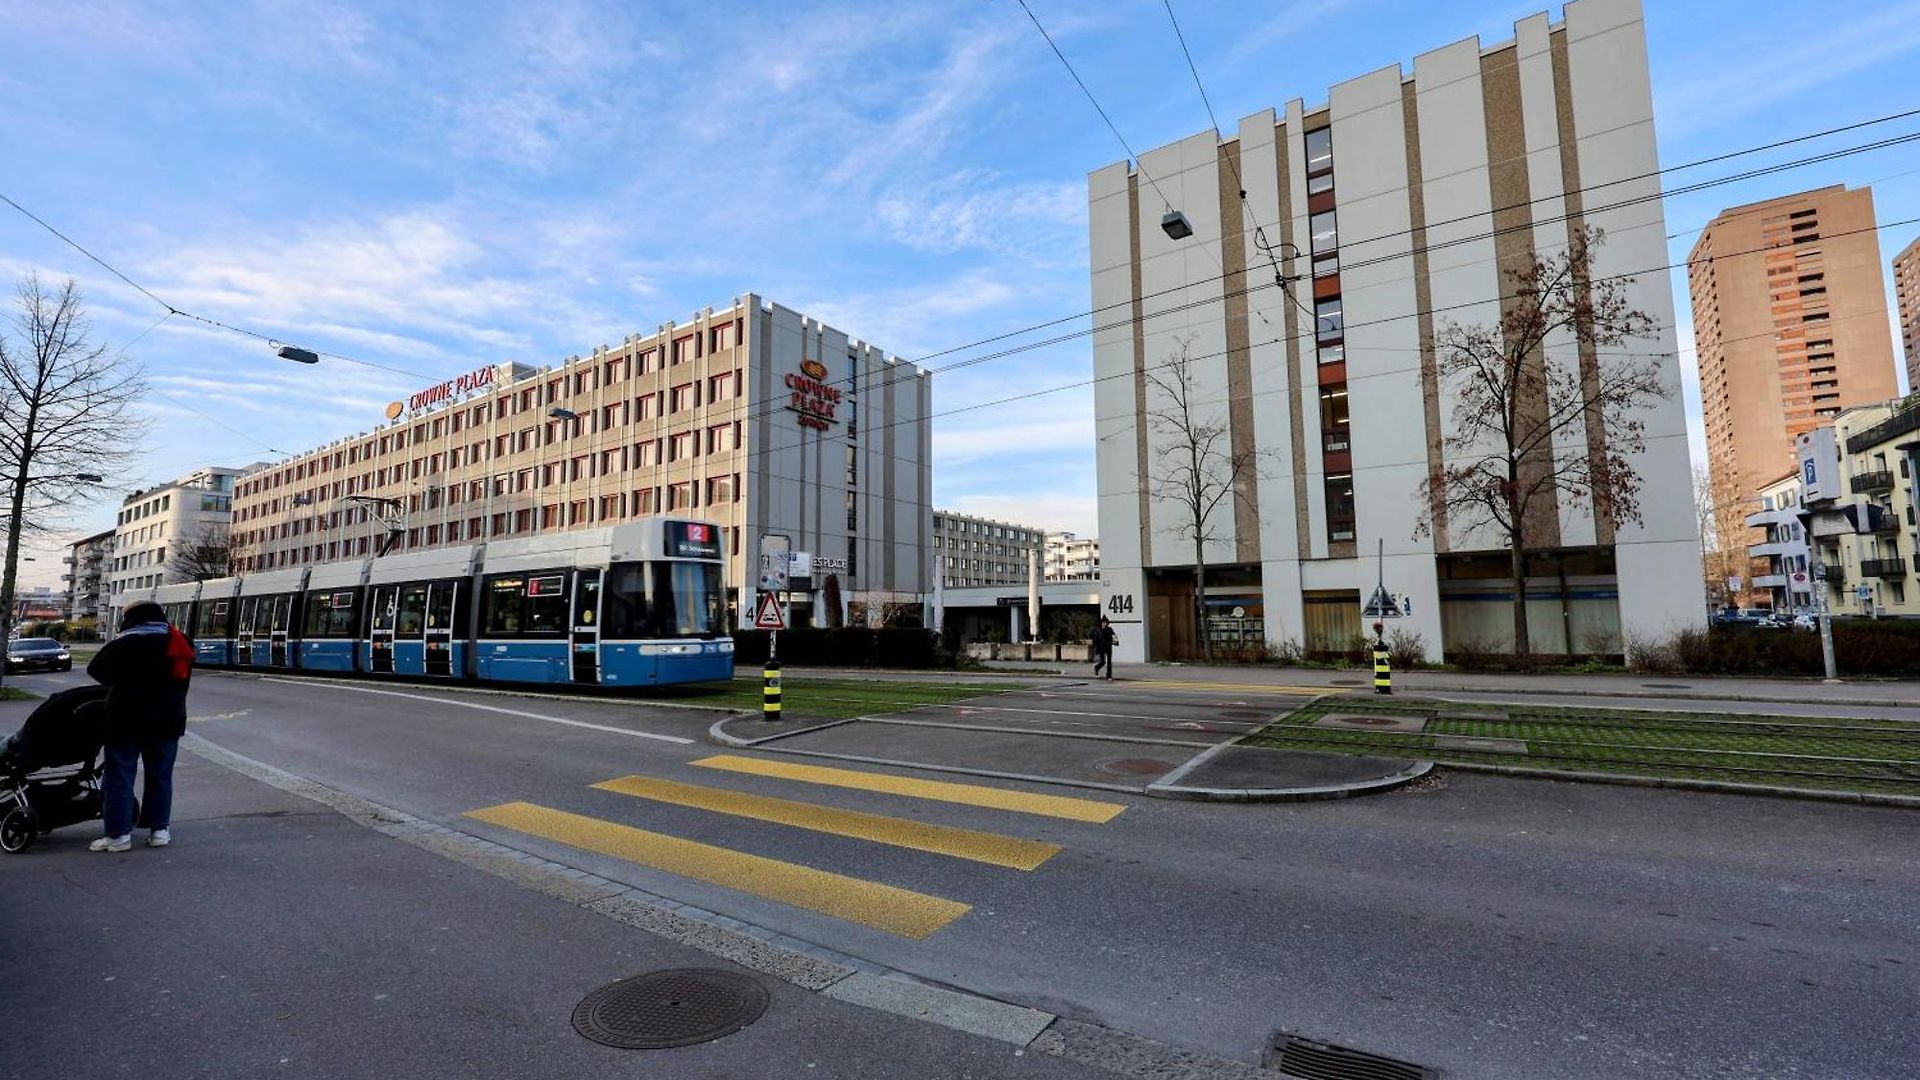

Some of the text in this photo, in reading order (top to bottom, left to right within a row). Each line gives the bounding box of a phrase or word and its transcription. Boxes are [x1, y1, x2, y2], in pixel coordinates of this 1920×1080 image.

[410, 364, 495, 411] CROWNE PLAZA
[785, 373, 841, 404] CROWNE
[792, 392, 834, 418] PLAZA
[693, 526, 702, 540] 2
[1108, 594, 1134, 613] 414
